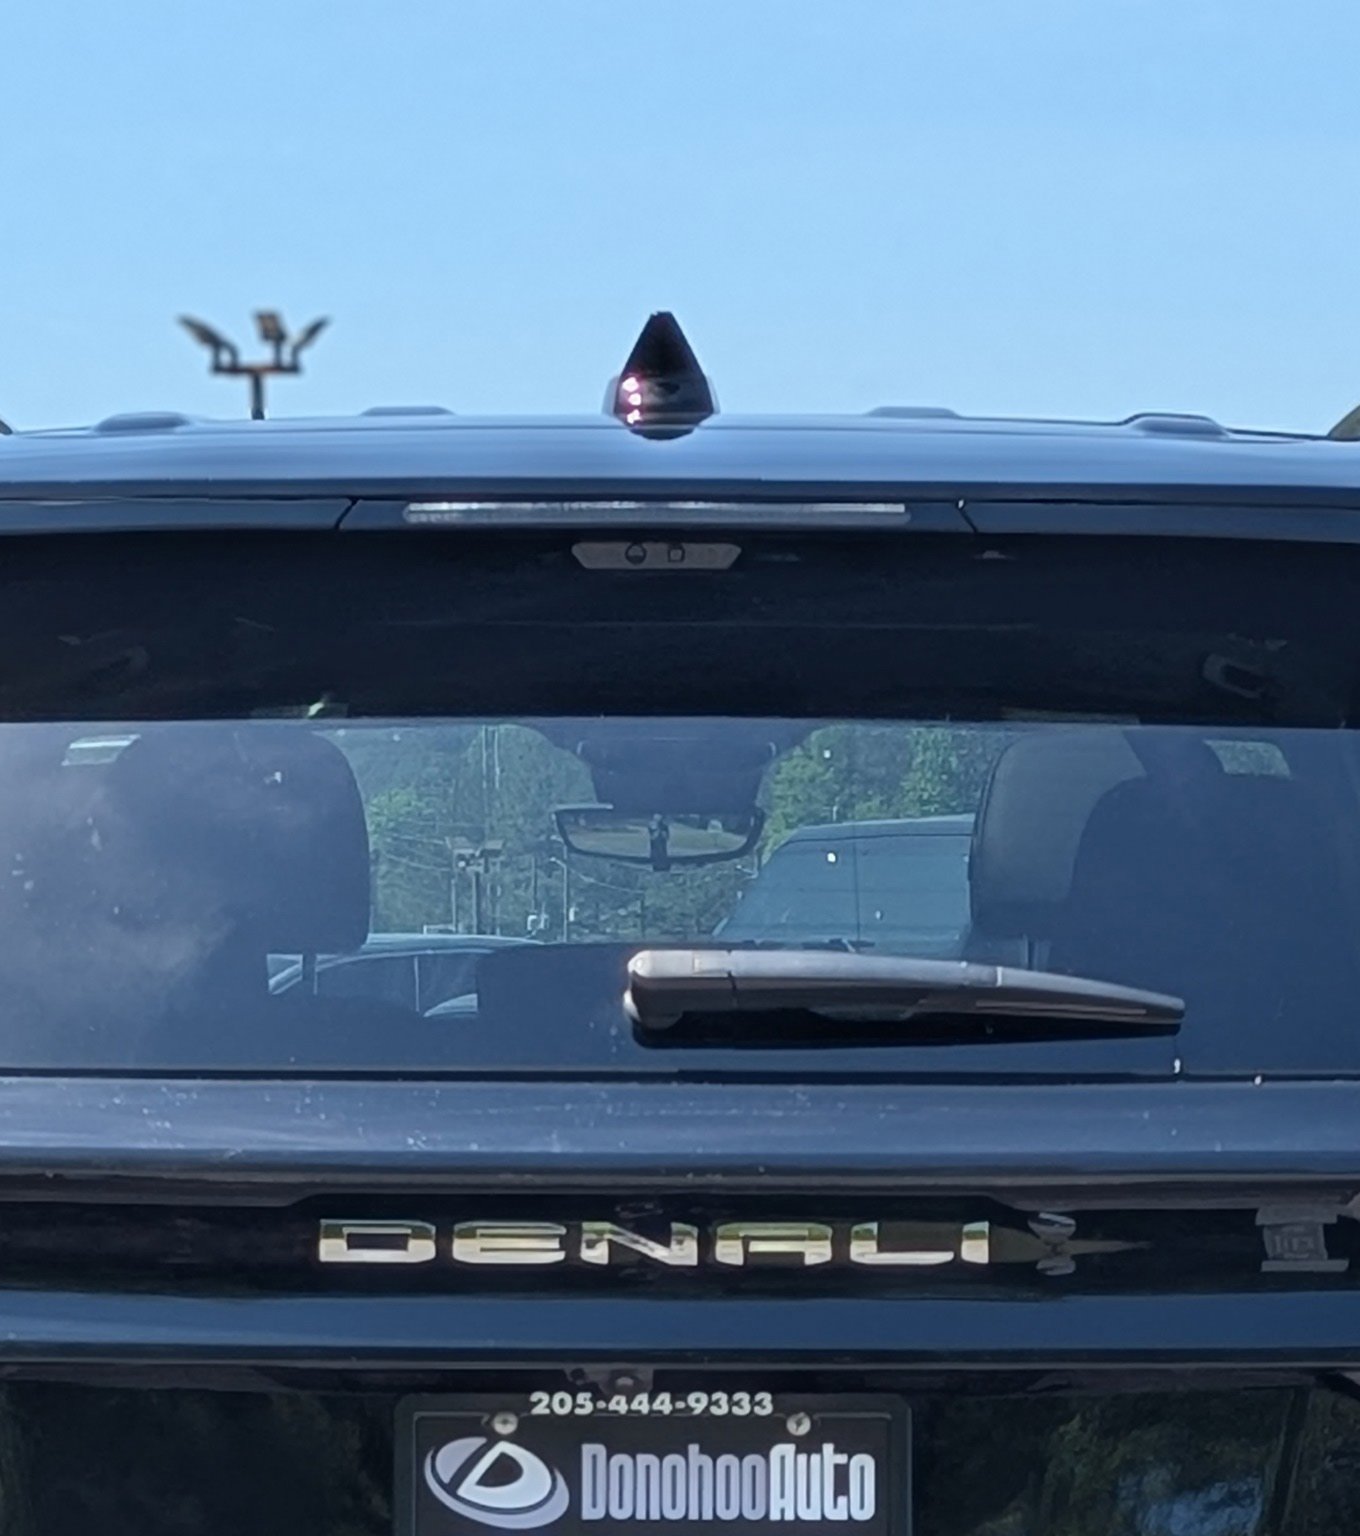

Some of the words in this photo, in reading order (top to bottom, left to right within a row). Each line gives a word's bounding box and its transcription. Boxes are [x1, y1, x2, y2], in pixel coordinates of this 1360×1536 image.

[318, 1218, 989, 1266] DENALI
[529, 1392, 774, 1416] 205-444-9333
[580, 1442, 876, 1521] DonohooAuto
